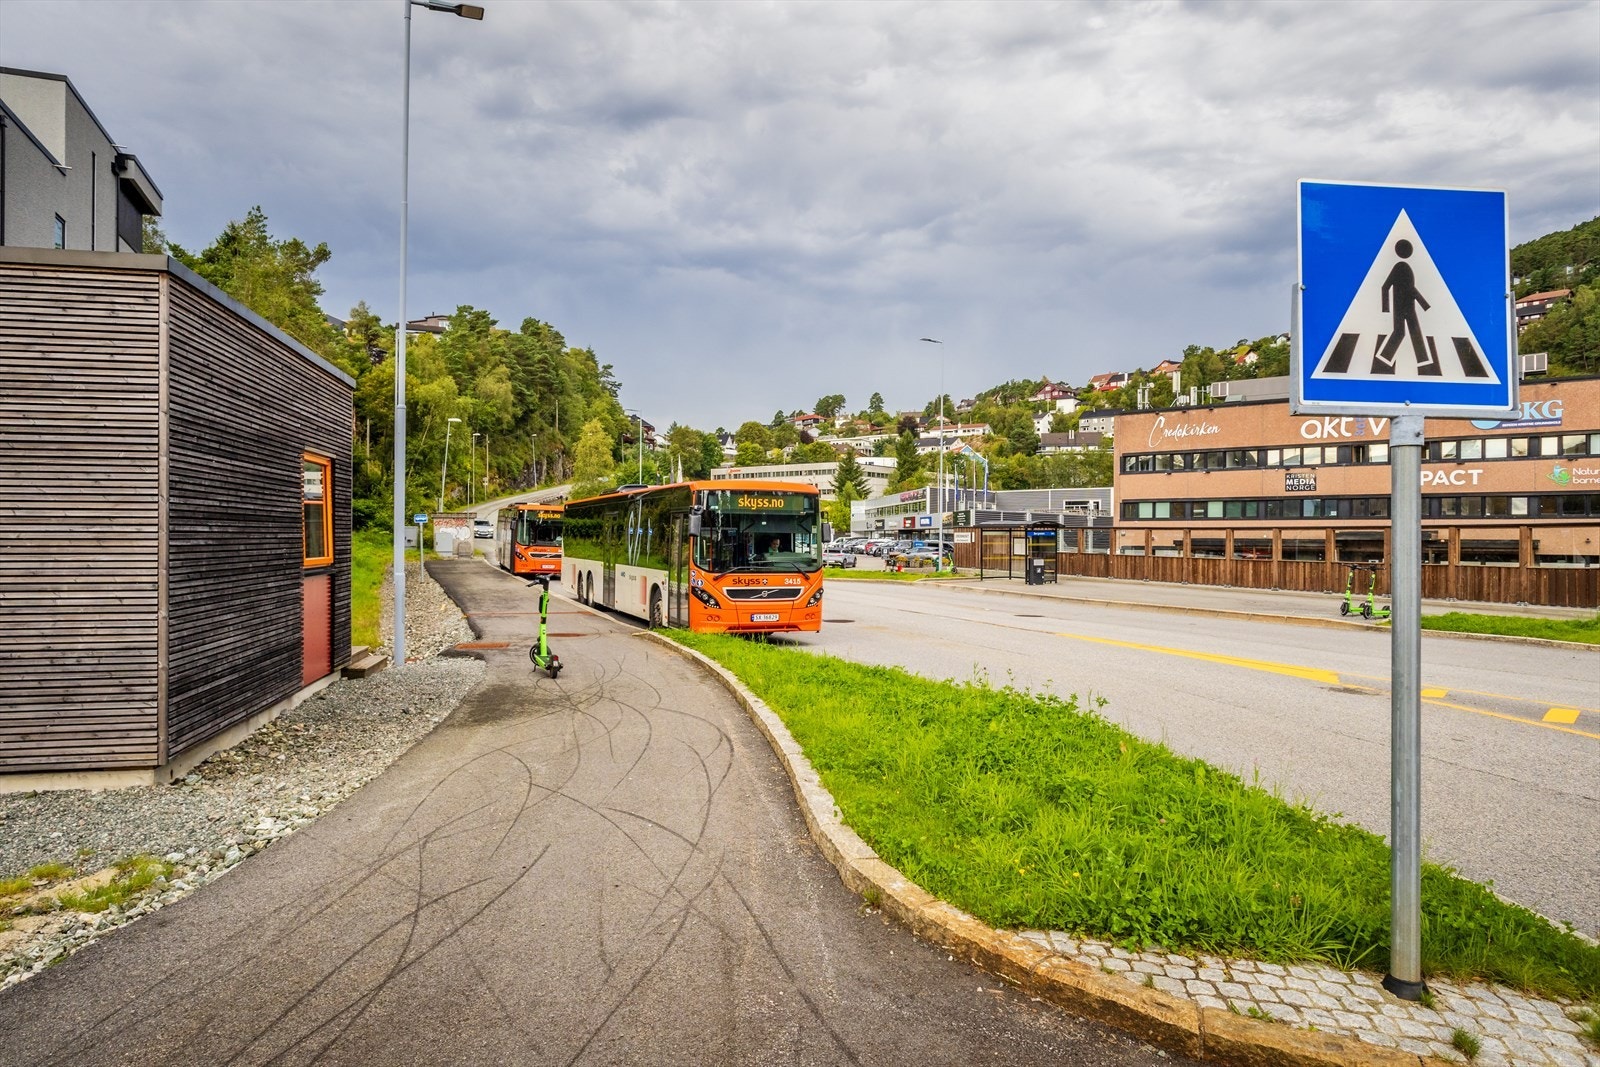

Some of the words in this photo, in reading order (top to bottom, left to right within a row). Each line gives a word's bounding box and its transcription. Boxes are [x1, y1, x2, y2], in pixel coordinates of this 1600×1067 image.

[1519, 400, 1564, 420] KG
[1149, 416, 1221, 447] Credokirken
[738, 495, 785, 509] skyss.no
[732, 577, 761, 586] skyss
